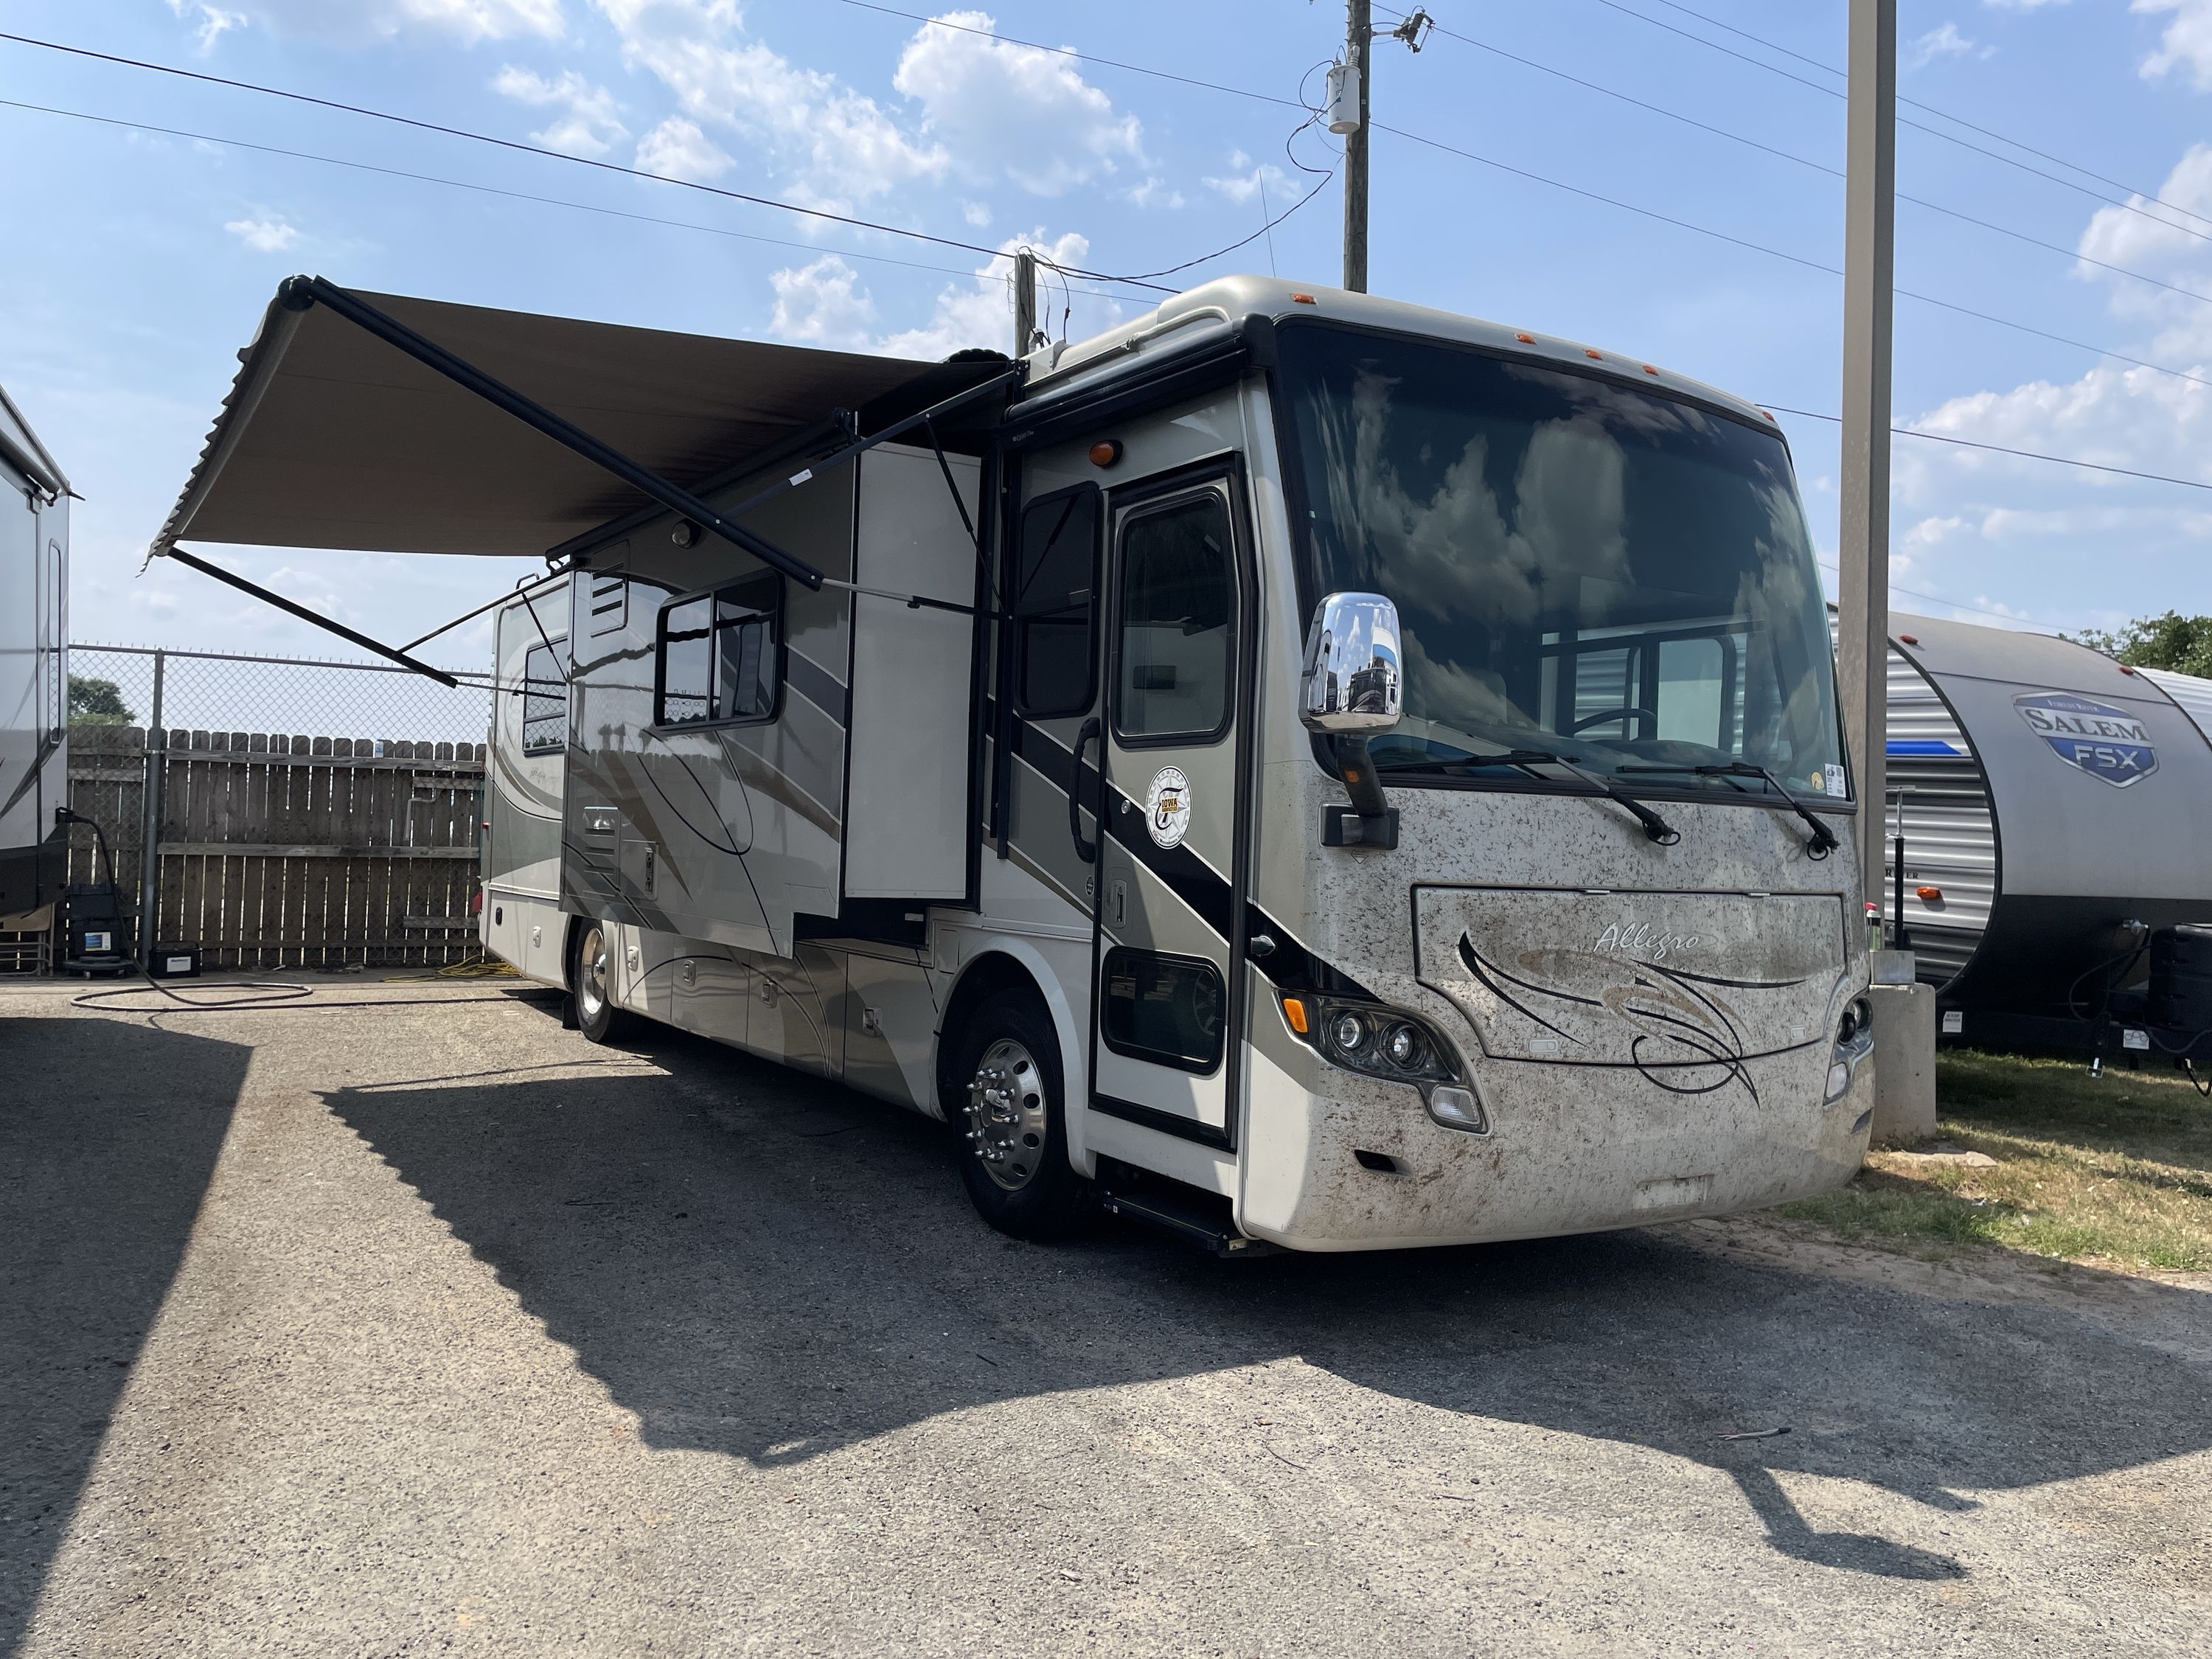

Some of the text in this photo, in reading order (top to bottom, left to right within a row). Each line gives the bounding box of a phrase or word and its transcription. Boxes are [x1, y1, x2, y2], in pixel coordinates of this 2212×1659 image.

[2025, 709, 2150, 742] SALEM
[2074, 745, 2140, 771] FSX
[1161, 798, 1178, 808] IOWA
[1885, 868, 1919, 879] RER
[1593, 922, 1700, 959] Allegro
